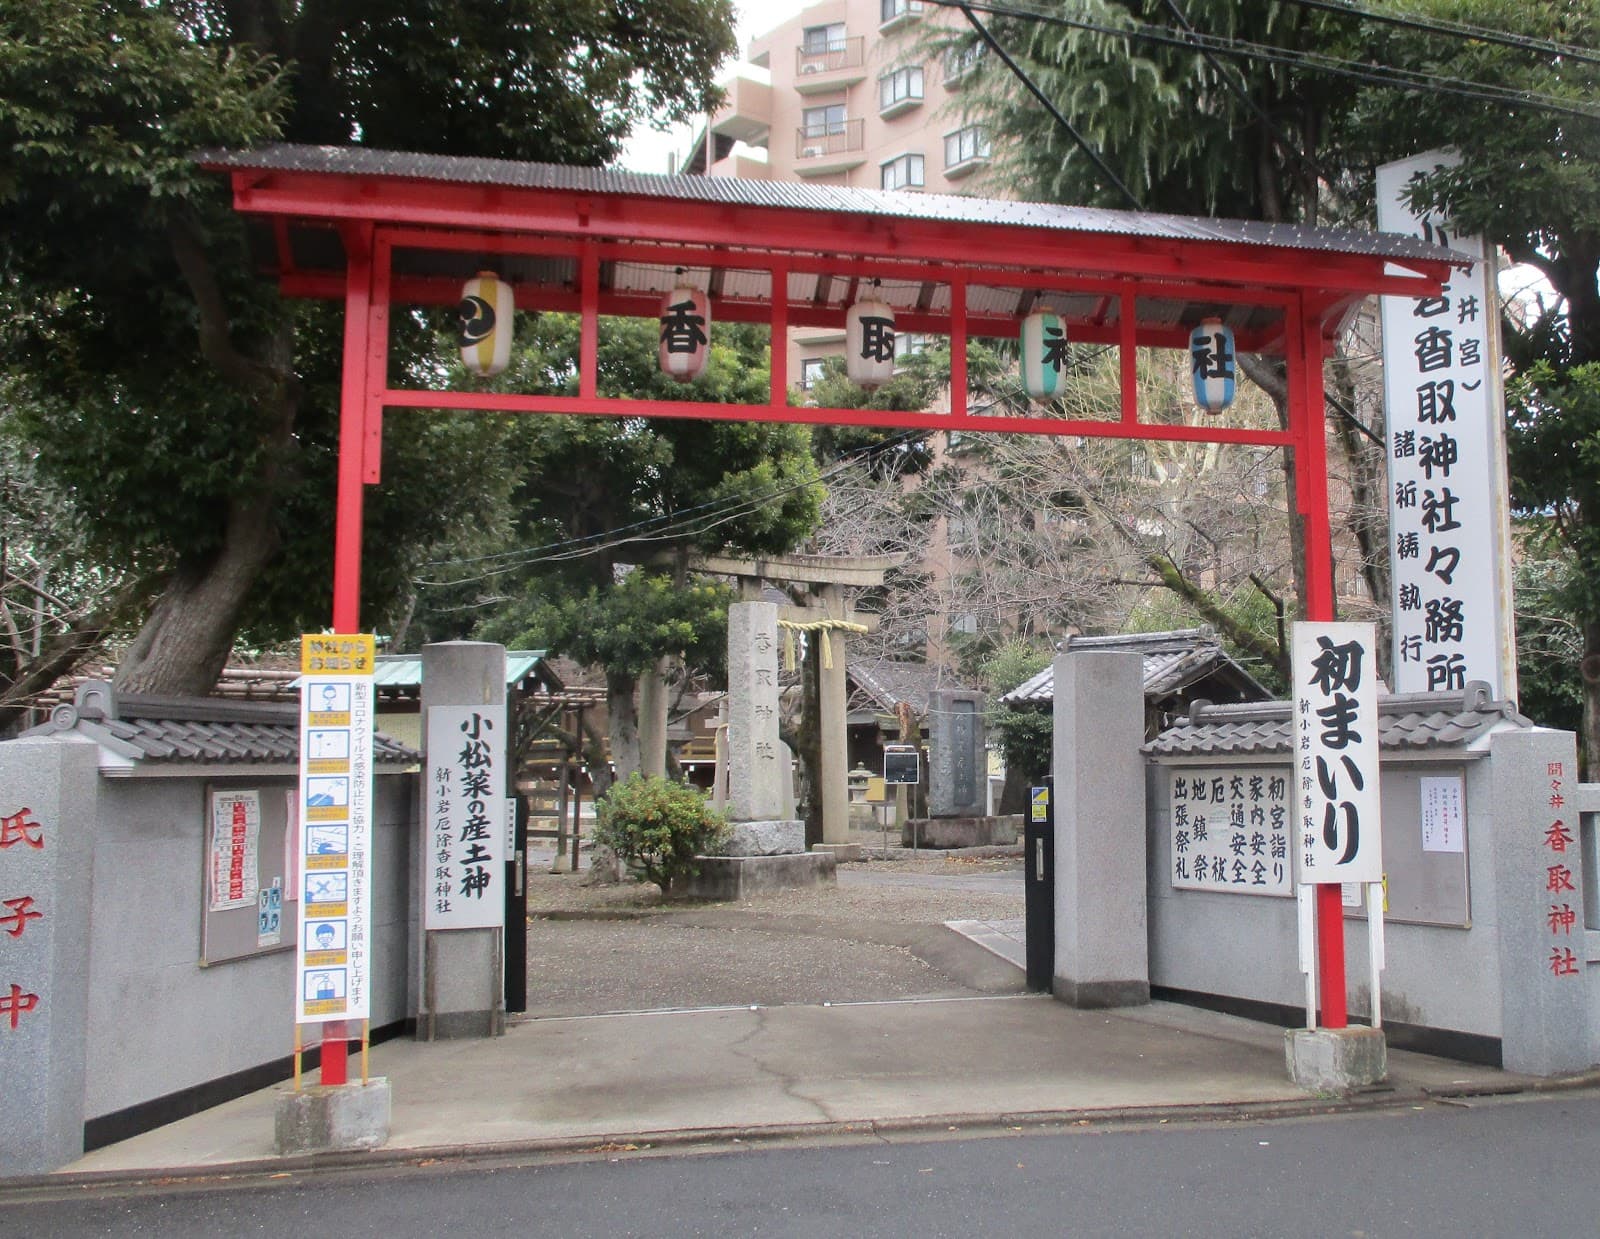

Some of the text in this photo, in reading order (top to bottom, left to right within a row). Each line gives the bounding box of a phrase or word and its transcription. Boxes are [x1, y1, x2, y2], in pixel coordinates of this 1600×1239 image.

[660, 300, 708, 354] 香
[1192, 332, 1235, 380] 社
[1299, 698, 1316, 867] 新小岩厄除香取神社
[1308, 635, 1364, 865] 初まいり
[434, 767, 452, 914] 新小岩厄除香取神社
[458, 712, 493, 900] 小松菜の産土神
[1174, 776, 1190, 880] 出張祭礼
[1191, 777, 1208, 881] 地鎮祭
[1229, 775, 1247, 884] 交通安全
[1249, 775, 1267, 885] 家内安全
[1268, 775, 1286, 884] 初宮詣り
[0, 807, 44, 1030] 氏子中
